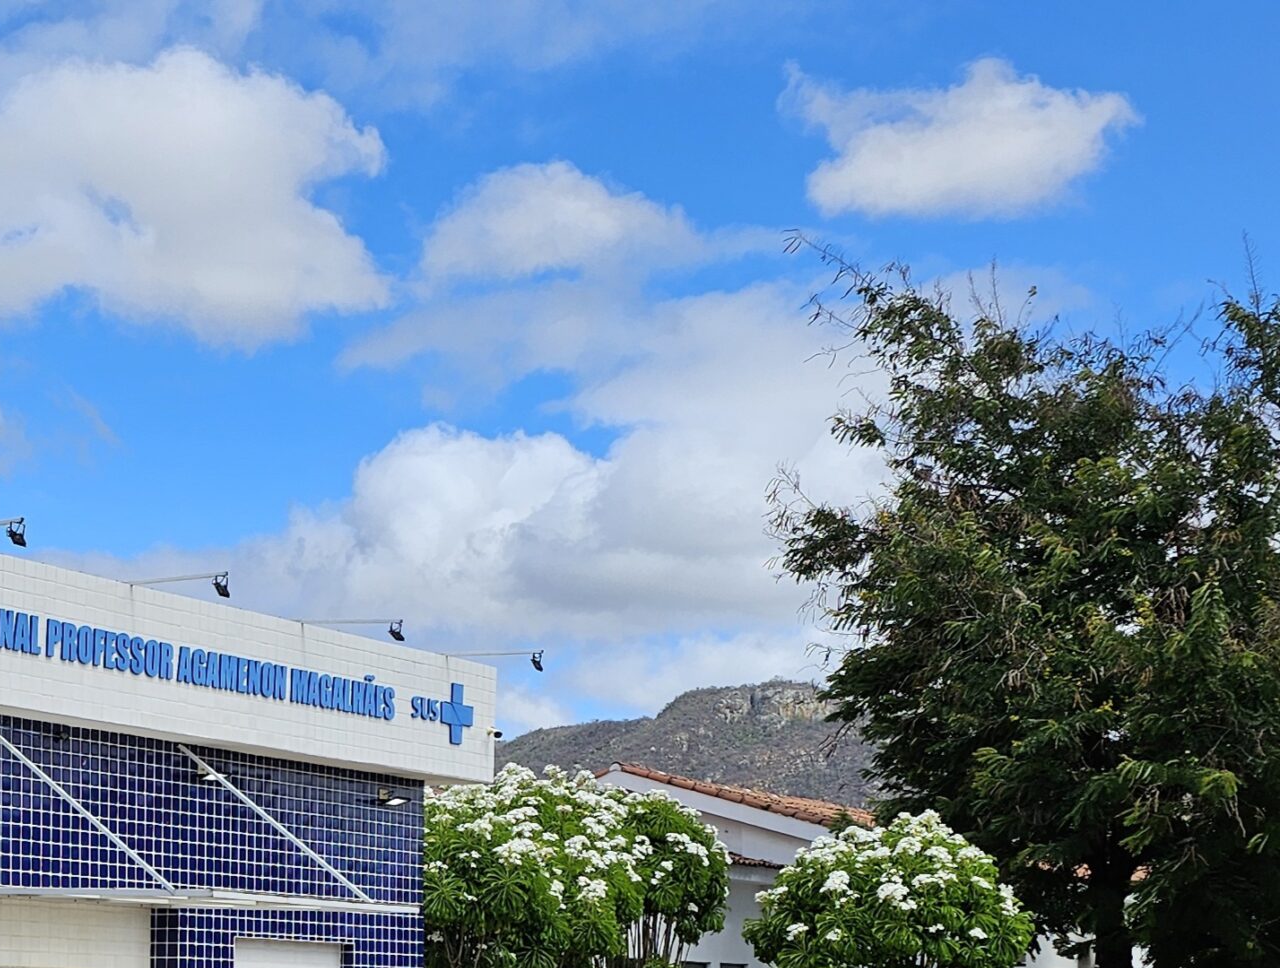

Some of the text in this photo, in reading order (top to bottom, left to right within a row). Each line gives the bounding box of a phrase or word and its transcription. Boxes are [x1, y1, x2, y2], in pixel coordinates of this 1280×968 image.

[45, 618, 174, 680] PROFESSOR
[177, 646, 288, 701] AGAMENON
[290, 668, 396, 721] MAGALHÃES
[411, 696, 439, 721] SUS
